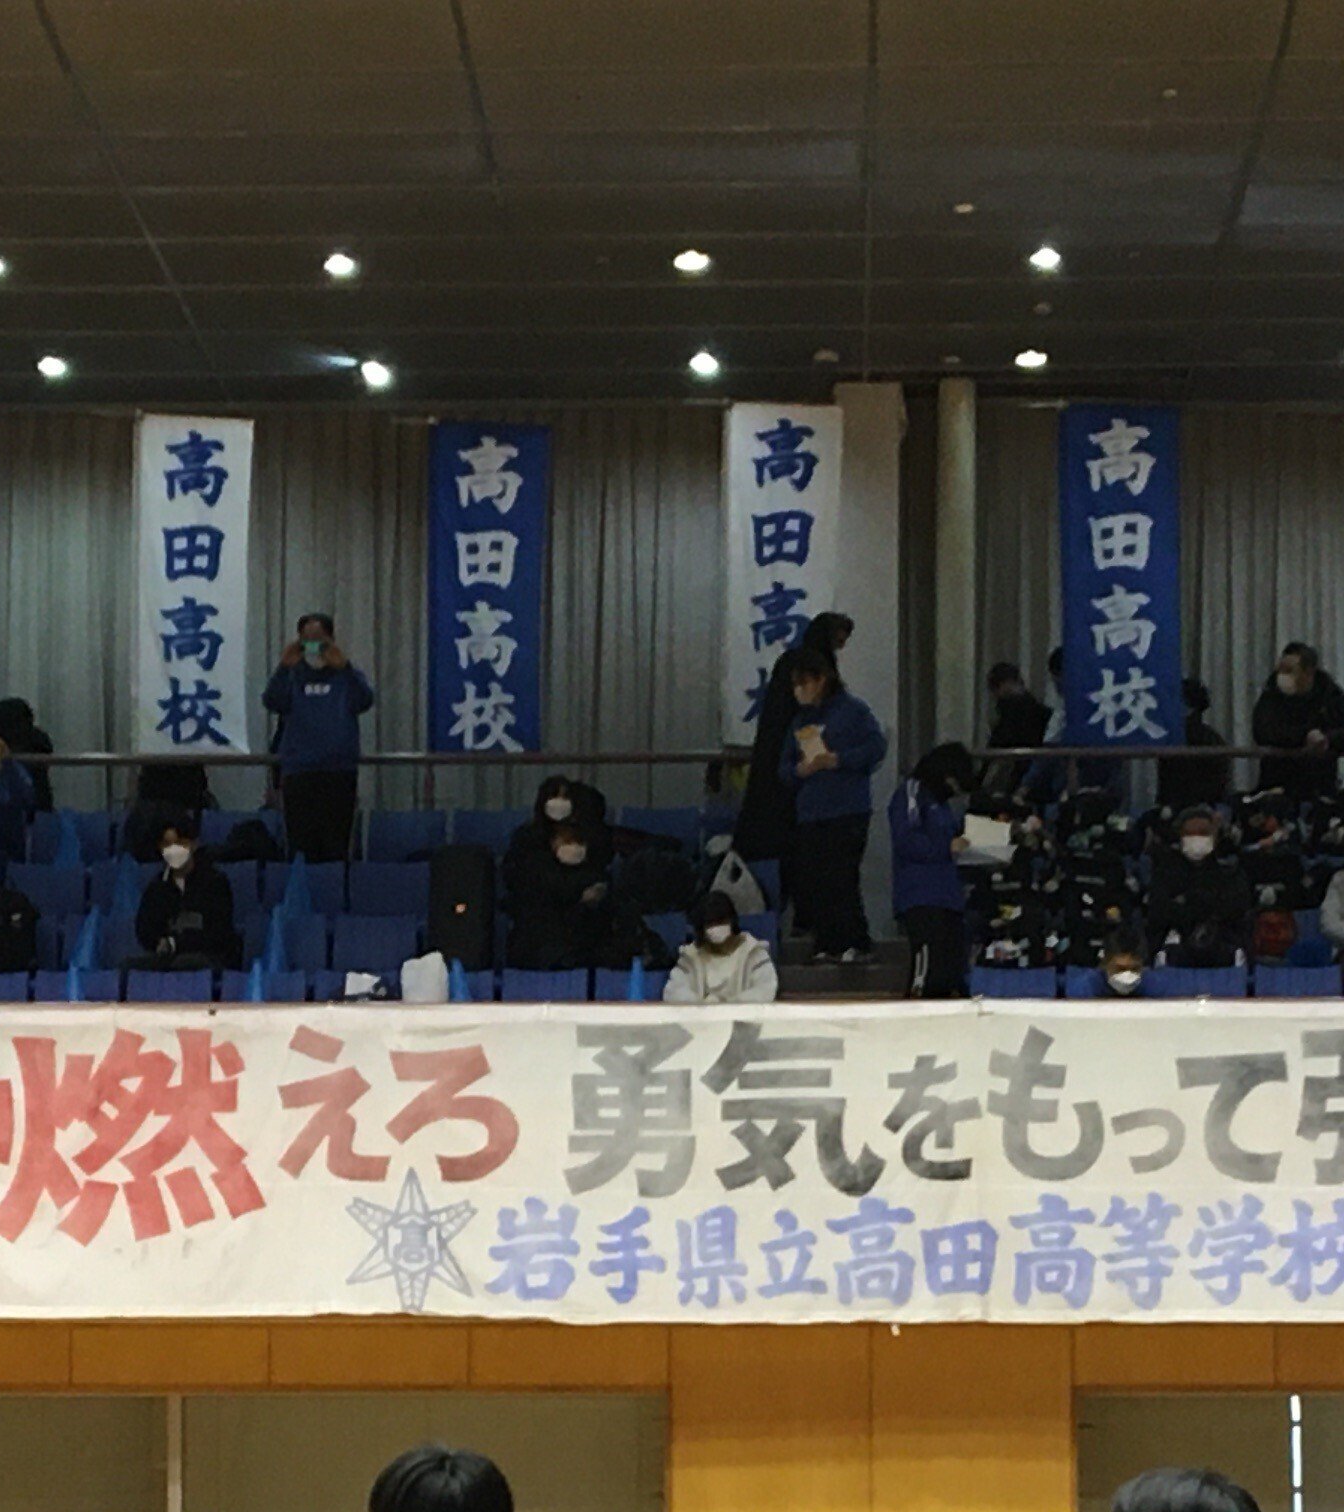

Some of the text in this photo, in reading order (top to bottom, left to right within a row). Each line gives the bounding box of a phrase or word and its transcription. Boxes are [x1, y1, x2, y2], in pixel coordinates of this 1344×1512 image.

[157, 431, 231, 746] 高田高校
[450, 436, 523, 753] 高田高校
[743, 417, 819, 724] 高田高
[1086, 417, 1168, 740] 高田高校
